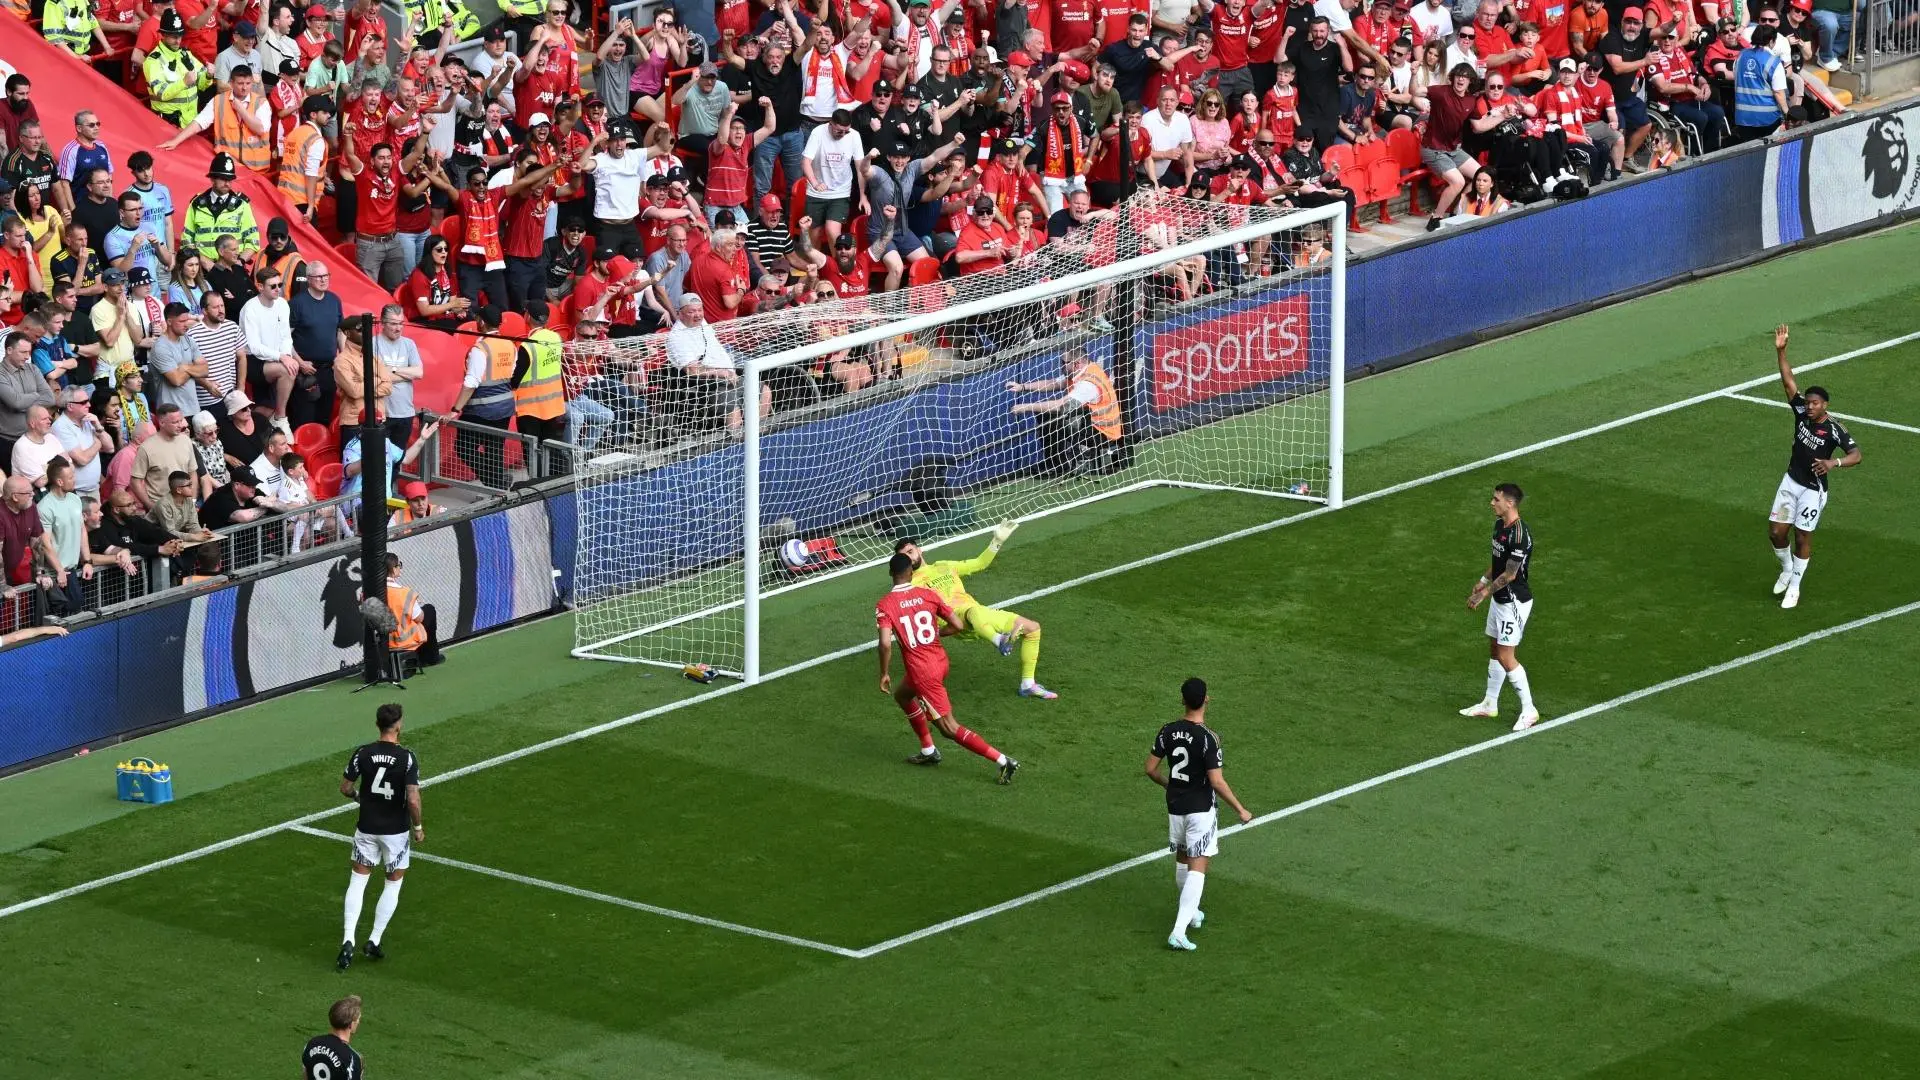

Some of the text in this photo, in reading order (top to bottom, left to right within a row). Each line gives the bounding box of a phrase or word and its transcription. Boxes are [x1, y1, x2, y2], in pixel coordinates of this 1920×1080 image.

[1162, 315, 1299, 396] sports
[1799, 421, 1825, 446] Emirates
[1801, 506, 1818, 522] 49
[900, 597, 923, 609] GAKPO
[899, 610, 936, 649] 18
[1500, 620, 1514, 636] 15
[371, 755, 397, 766] WHITE
[1171, 746, 1190, 782] 2
[371, 766, 395, 801] 4
